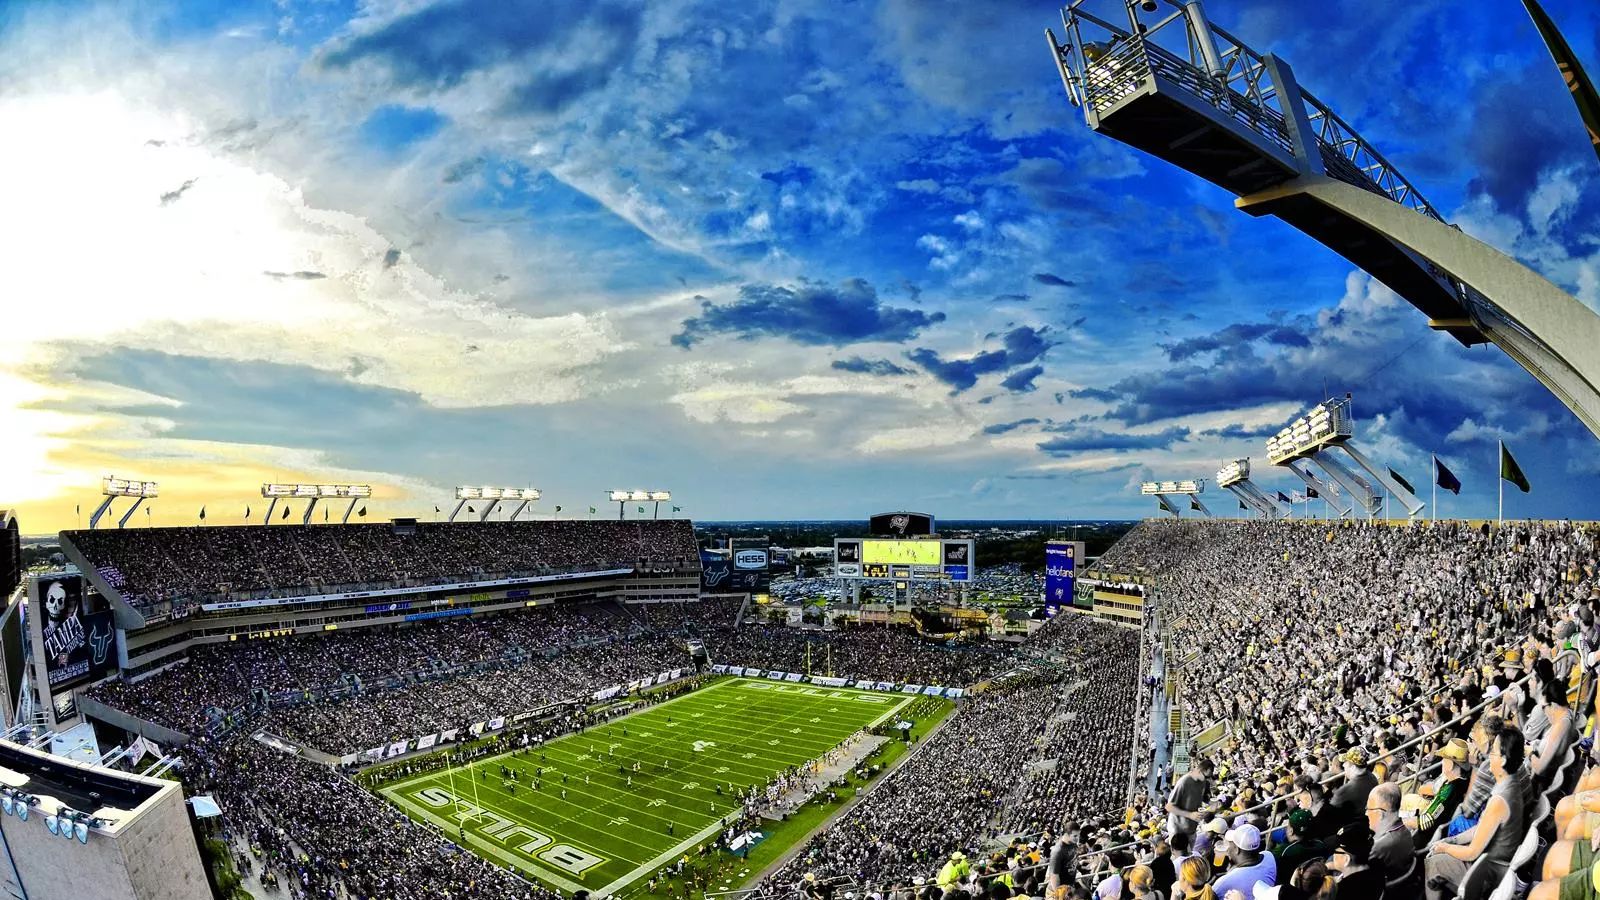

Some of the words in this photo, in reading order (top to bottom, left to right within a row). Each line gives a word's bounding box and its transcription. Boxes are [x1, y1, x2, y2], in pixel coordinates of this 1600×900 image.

[738, 555, 765, 563] HESS
[45, 614, 83, 660] TAMPA
[409, 786, 608, 877] BULLS
